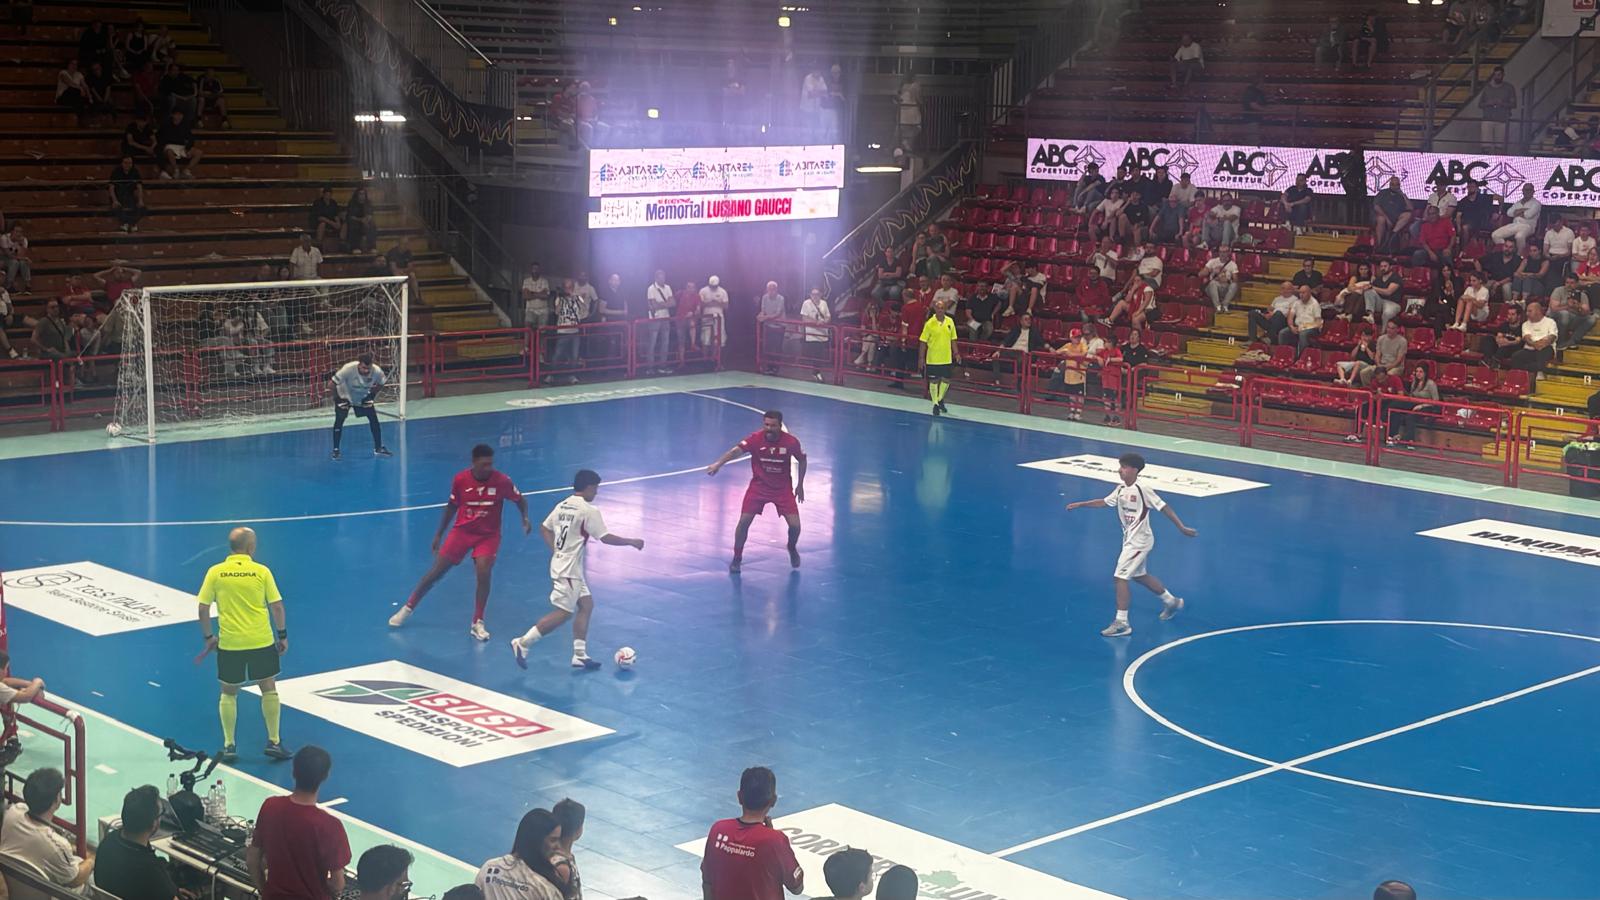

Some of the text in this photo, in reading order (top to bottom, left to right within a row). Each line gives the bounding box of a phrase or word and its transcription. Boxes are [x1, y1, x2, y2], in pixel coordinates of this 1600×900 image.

[1031, 143, 1079, 167] ABC
[1118, 145, 1171, 170] ABC
[1213, 151, 1265, 176] ABC
[1305, 152, 1342, 179] AB
[1425, 159, 1491, 187] ABC
[646, 199, 704, 221] Memorial
[755, 197, 792, 216] GAUCCI
[375, 710, 484, 748] SPEDIZIONI
[400, 705, 504, 742] TRASPORTI
[419, 697, 546, 736] SUSA
[720, 842, 755, 858] Pappalardo
